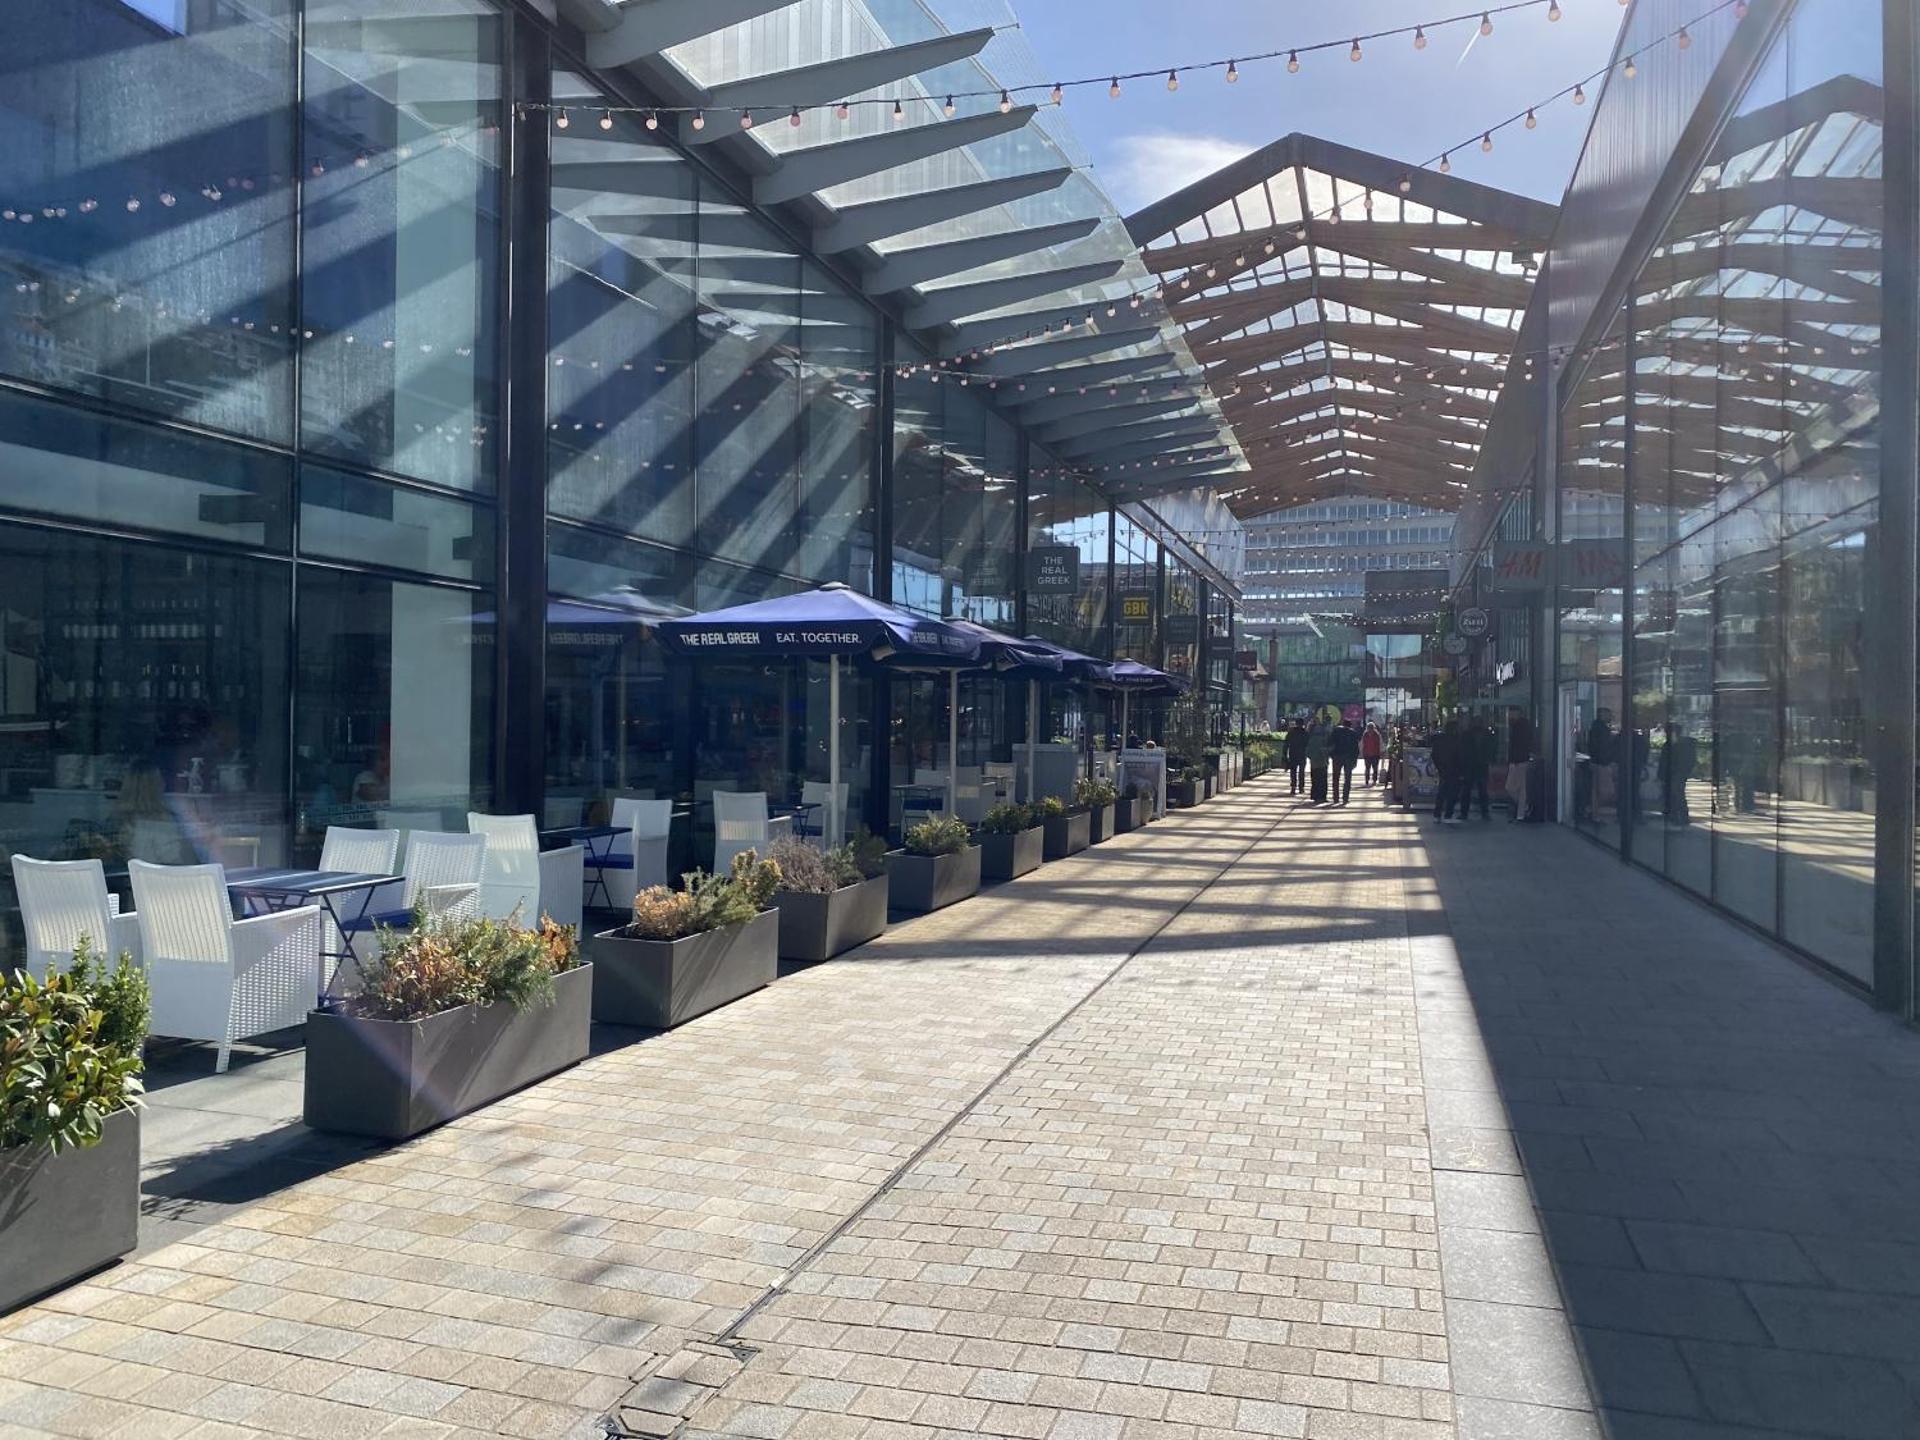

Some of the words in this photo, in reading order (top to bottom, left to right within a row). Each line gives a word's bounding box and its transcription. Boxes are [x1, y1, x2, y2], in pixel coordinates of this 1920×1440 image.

[1043, 556, 1064, 565] THE
[1041, 566, 1069, 575] REAL
[1037, 576, 1071, 585] GREEK
[1123, 601, 1149, 615] GBK
[680, 634, 700, 646] THE
[701, 632, 727, 645] REAL
[727, 632, 760, 645] GREEK
[776, 632, 800, 644] EAT.
[801, 632, 863, 644] TOGETHER.
